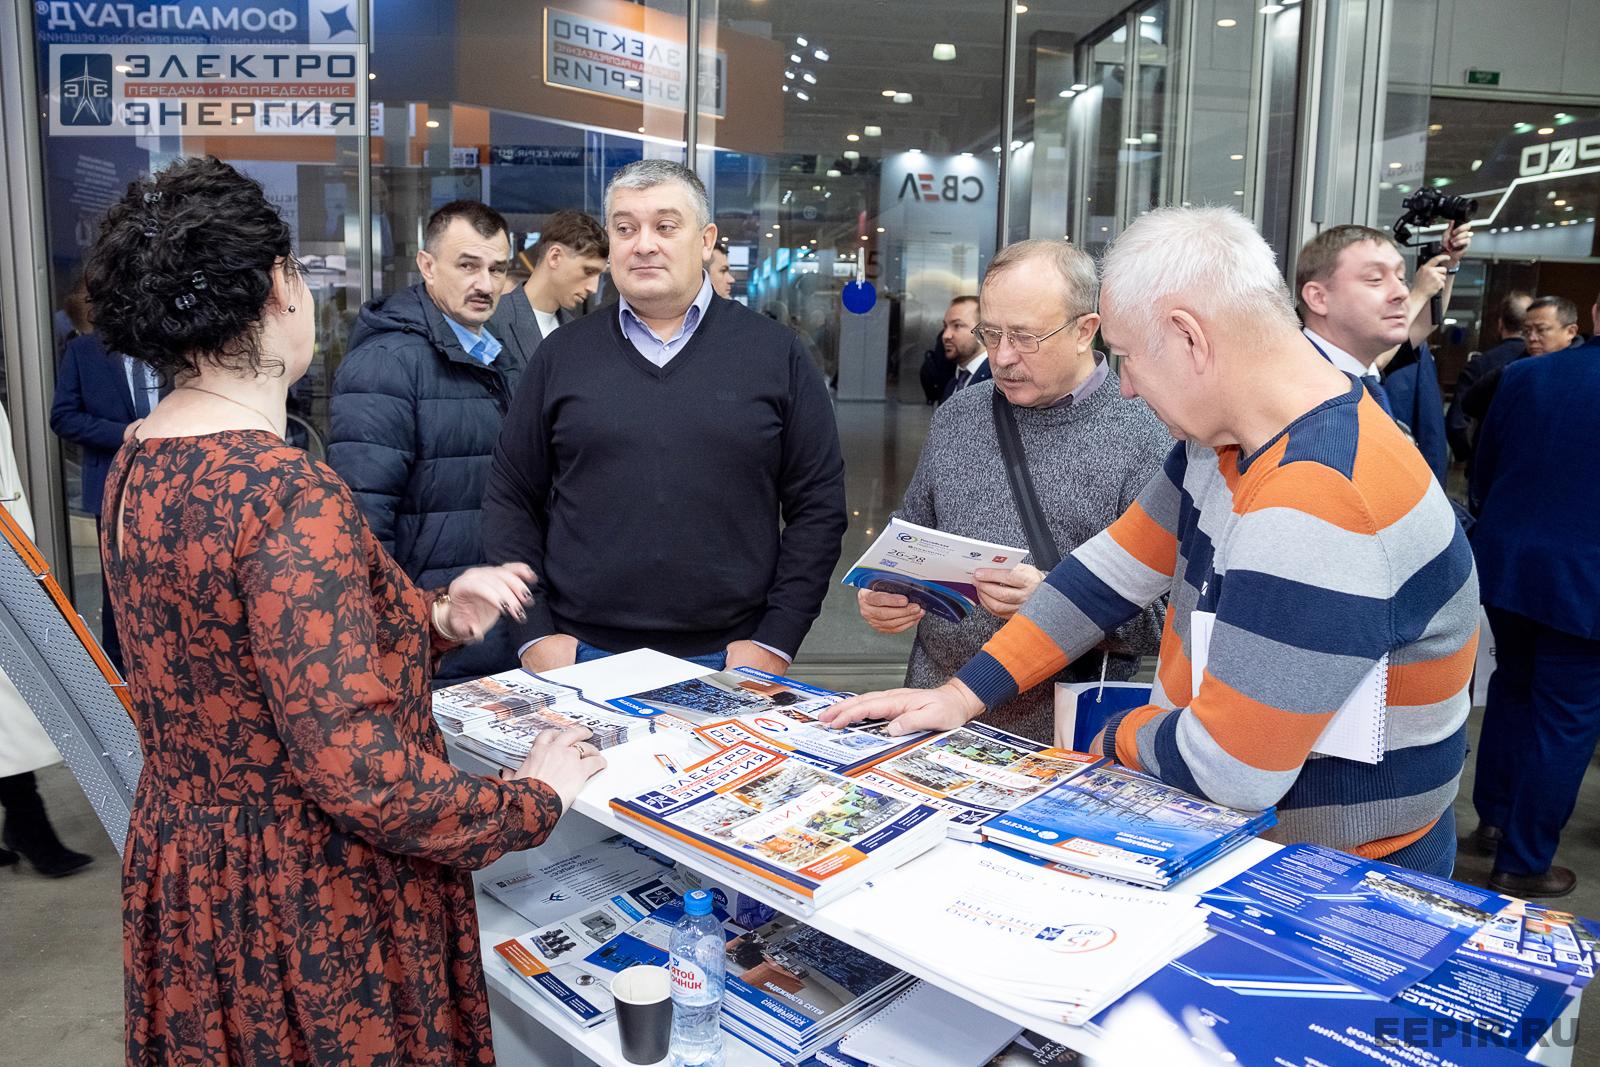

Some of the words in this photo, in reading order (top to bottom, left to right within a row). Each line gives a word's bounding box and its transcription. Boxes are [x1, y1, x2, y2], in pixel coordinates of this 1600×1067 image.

[662, 746, 751, 792] ЭЛЕКТРО
[677, 753, 768, 800] ЭНЕРГИЯ
[863, 774, 963, 814] ЭНЕРГИЯ
[999, 818, 1040, 835] РОССЕТИ
[760, 998, 807, 1027] СПЕЦВЫПУСК
[763, 981, 803, 1006] НАДЕЖНОСТЬ
[803, 1001, 825, 1017] СЕТЕЙ
